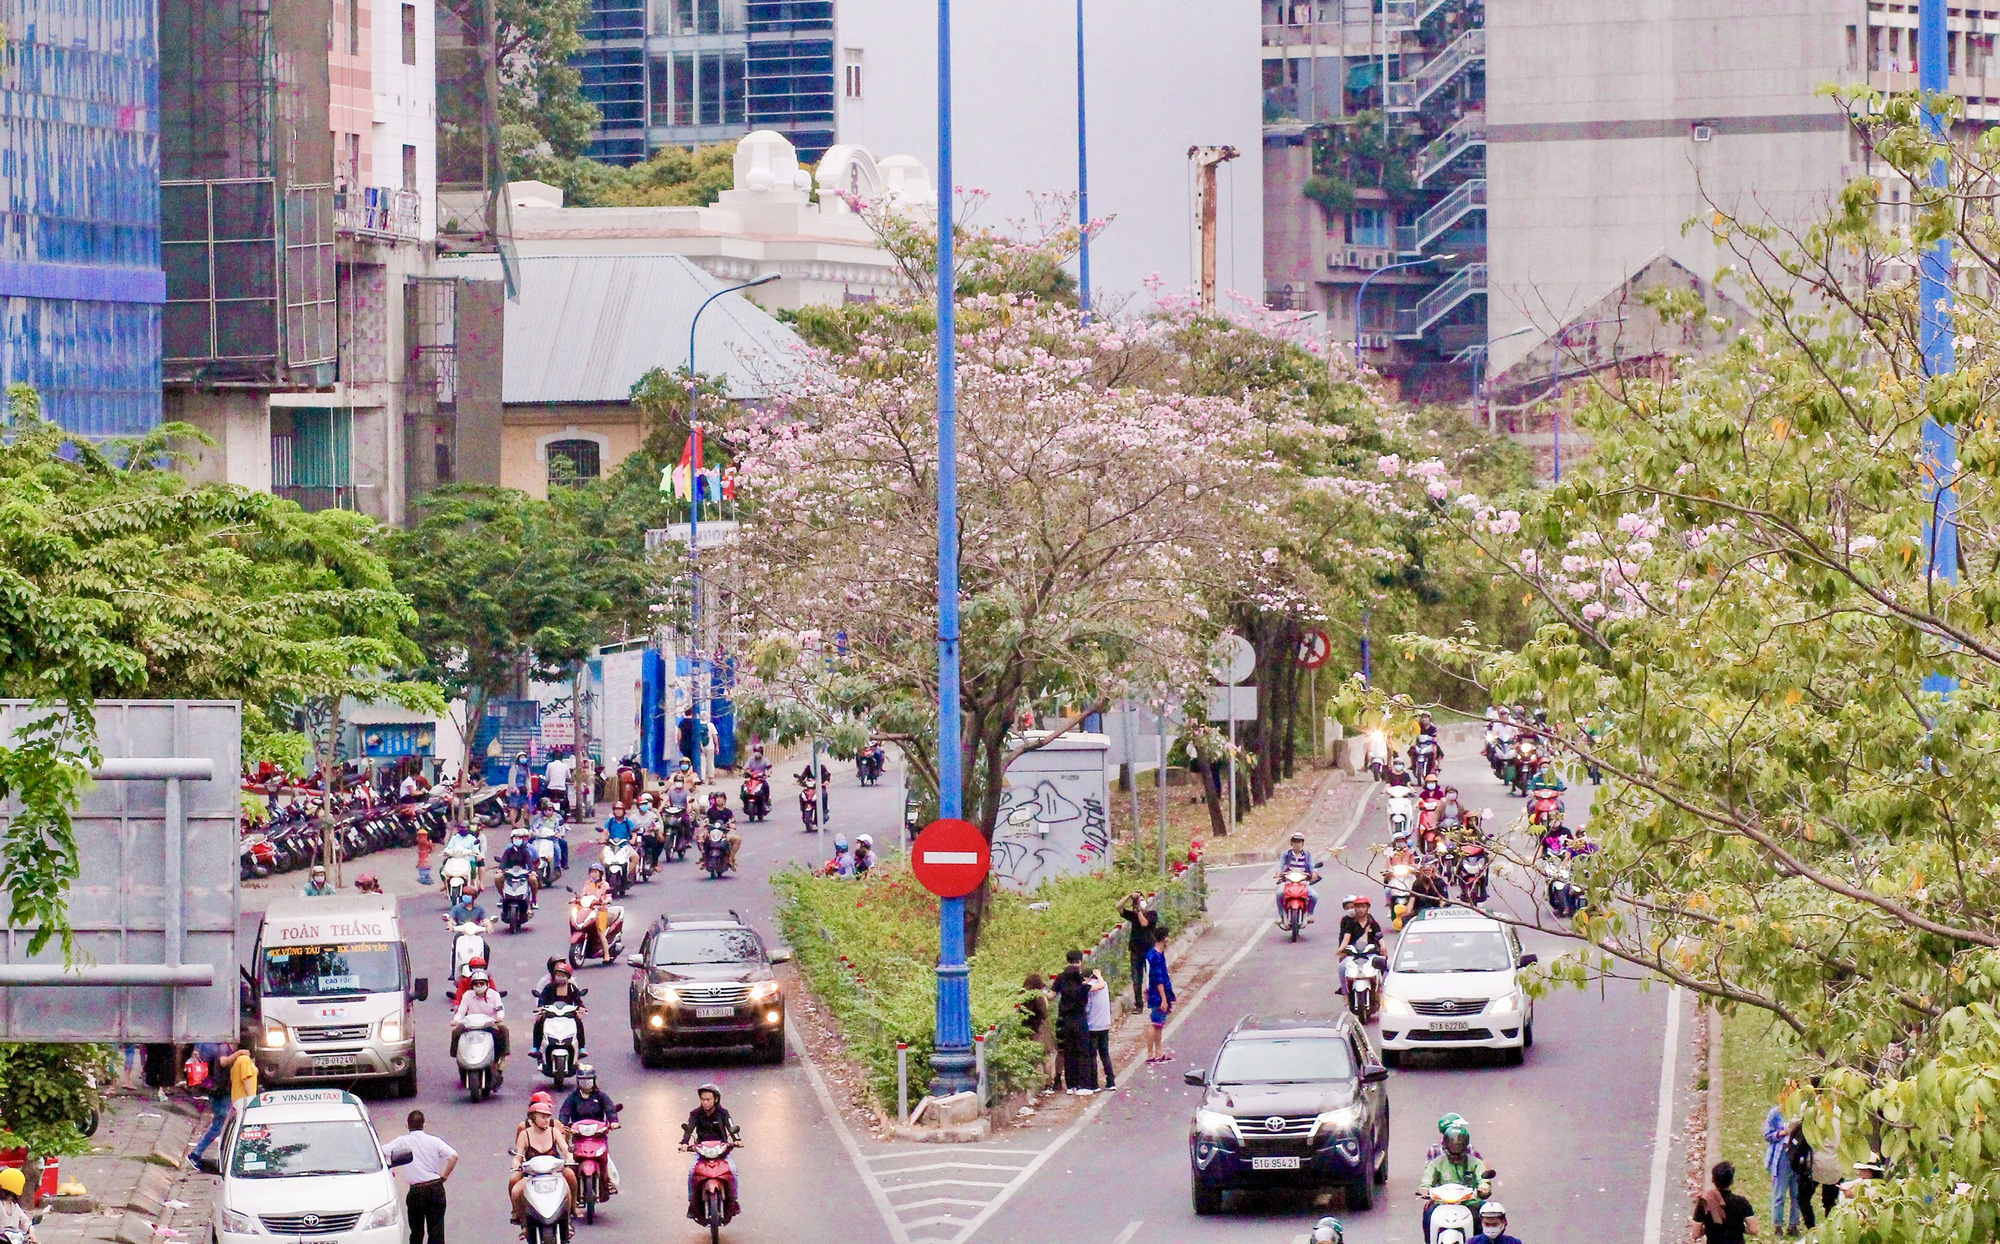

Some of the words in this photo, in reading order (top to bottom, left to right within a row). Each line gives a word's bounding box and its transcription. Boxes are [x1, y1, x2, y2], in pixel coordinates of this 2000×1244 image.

[280, 924, 320, 941] TOÀN
[330, 919, 382, 937] THẮNG
[304, 944, 321, 955] TÀU
[282, 1093, 322, 1102] VINASUN
[321, 1092, 341, 1101] TAXI
